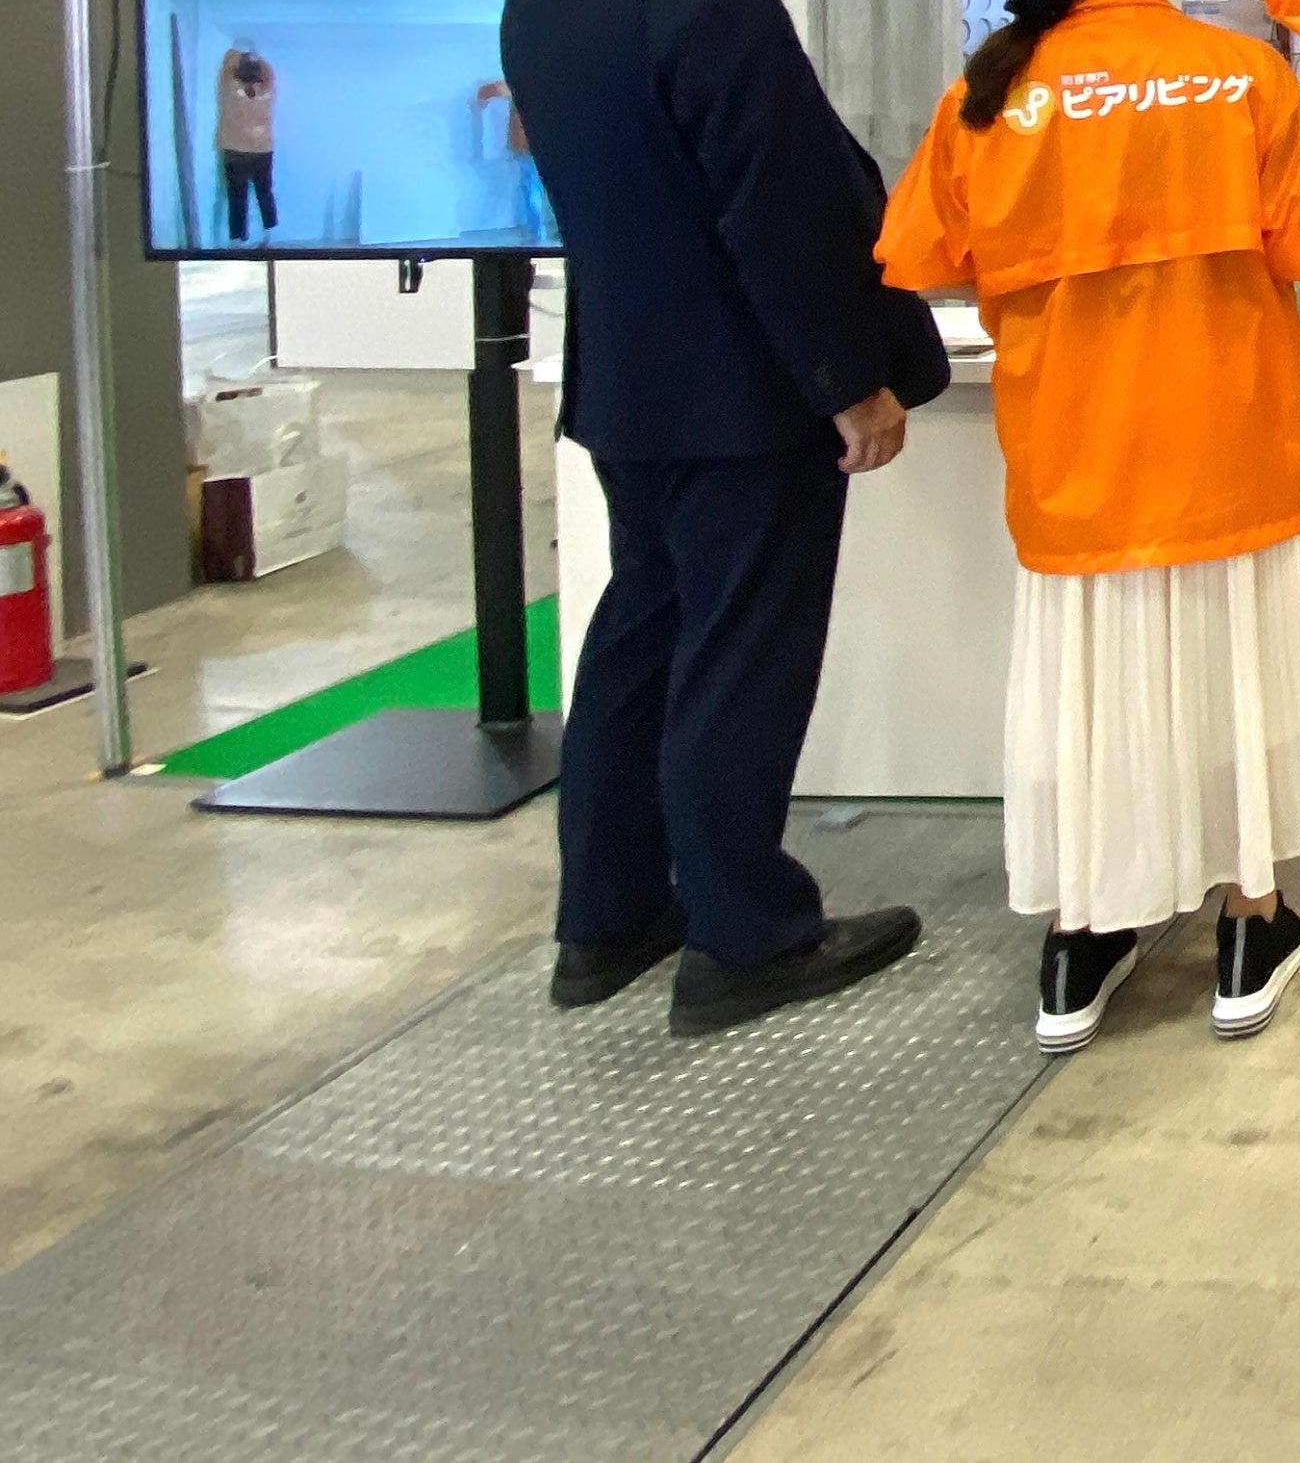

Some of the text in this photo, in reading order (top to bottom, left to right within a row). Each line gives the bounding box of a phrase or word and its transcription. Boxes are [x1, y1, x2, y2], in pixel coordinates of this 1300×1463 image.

[1062, 74, 1254, 119] ピアリビング
